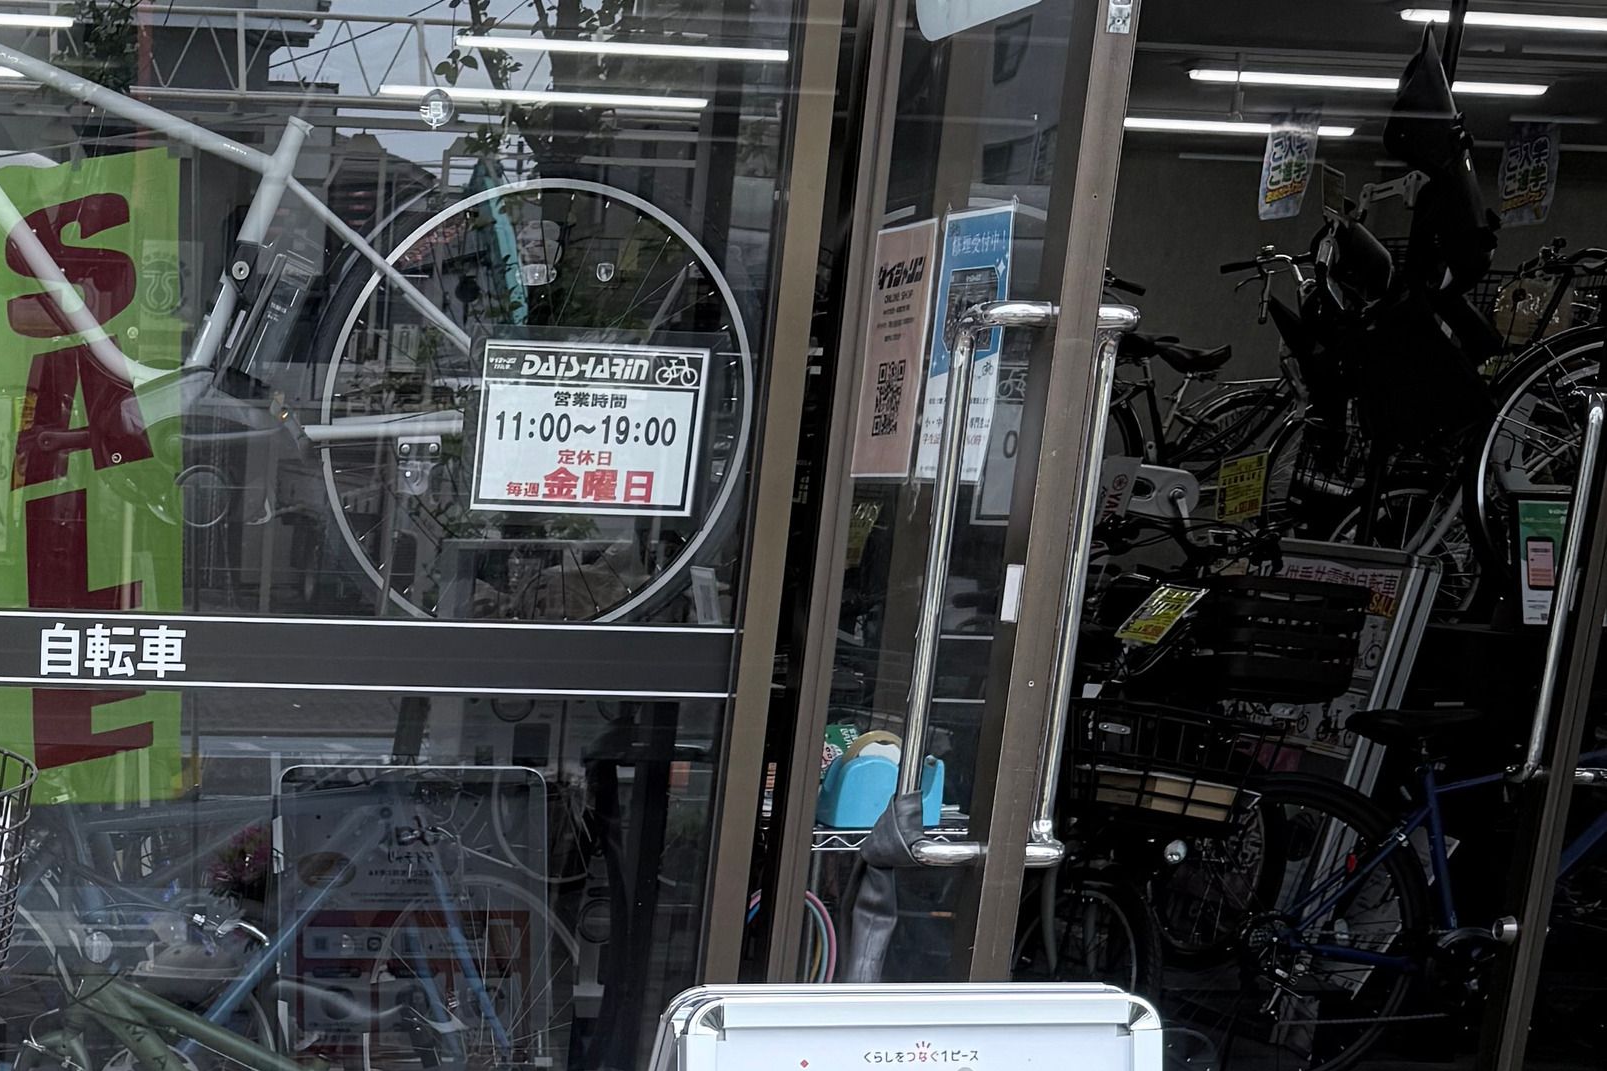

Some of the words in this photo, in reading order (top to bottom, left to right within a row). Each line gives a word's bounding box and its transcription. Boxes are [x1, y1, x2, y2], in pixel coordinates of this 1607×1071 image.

[553, 390, 628, 409] 営業時間
[557, 449, 613, 467] 定休日
[39, 622, 187, 679] 自転車
[863, 1050, 979, 1063] くらしをつなぐ1ピース
